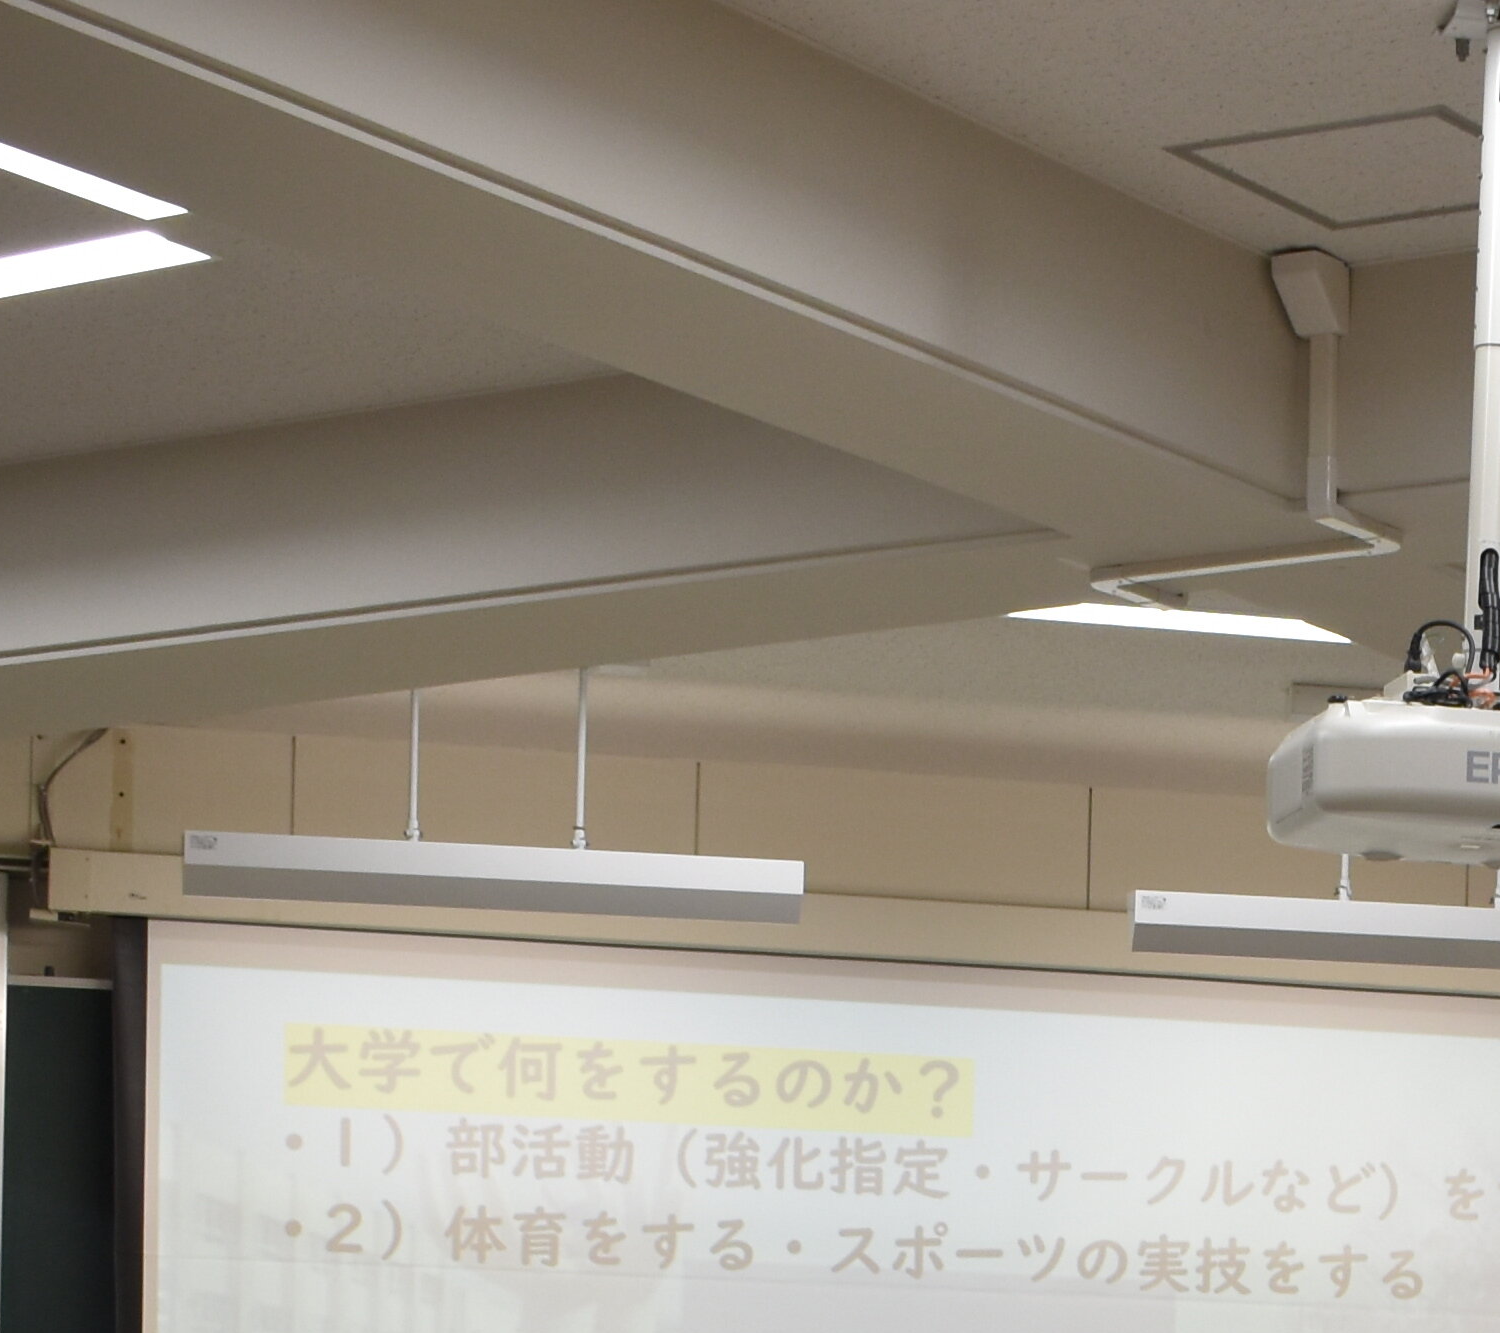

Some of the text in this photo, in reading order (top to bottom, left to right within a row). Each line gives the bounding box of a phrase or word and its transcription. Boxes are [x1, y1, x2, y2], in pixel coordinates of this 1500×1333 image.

[287, 1027, 960, 1119] 大学で何をするのか？
